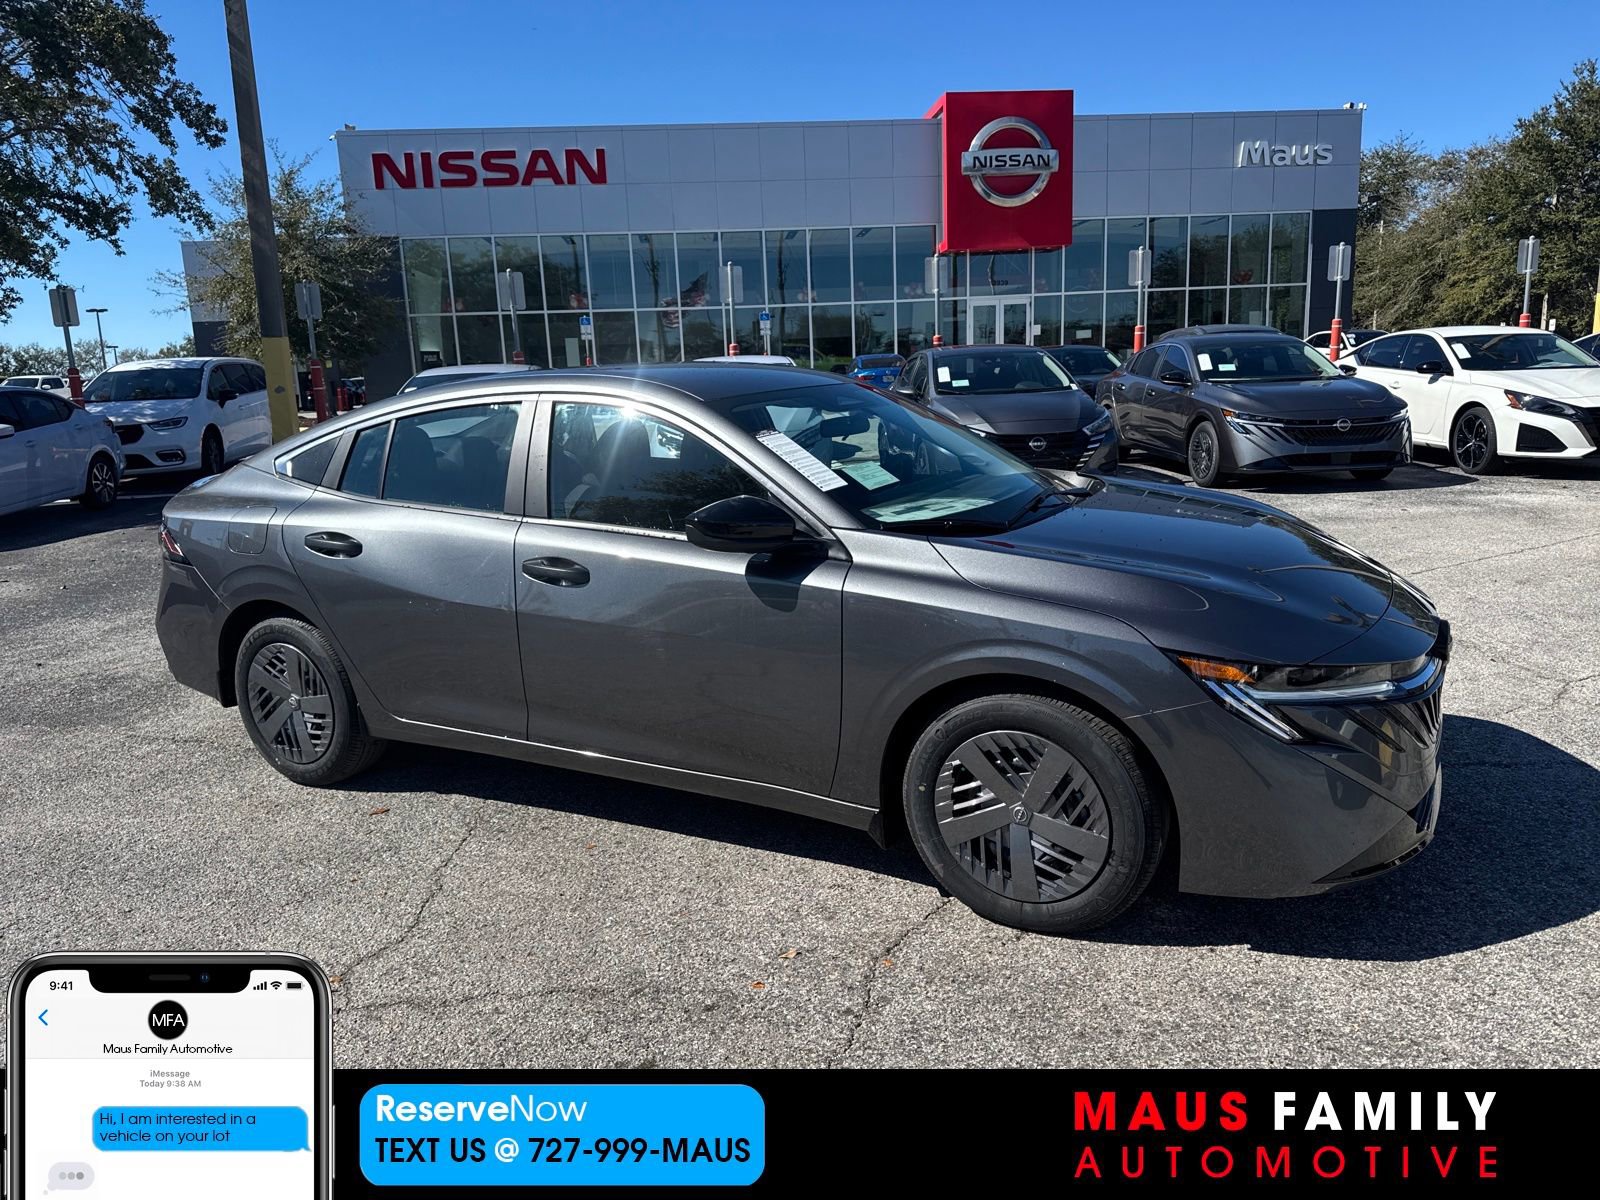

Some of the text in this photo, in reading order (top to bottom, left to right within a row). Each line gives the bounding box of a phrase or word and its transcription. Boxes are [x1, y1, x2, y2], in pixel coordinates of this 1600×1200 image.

[972, 153, 1051, 169] NISSAN
[1238, 140, 1333, 168] Maus
[371, 148, 608, 190] NISSAN
